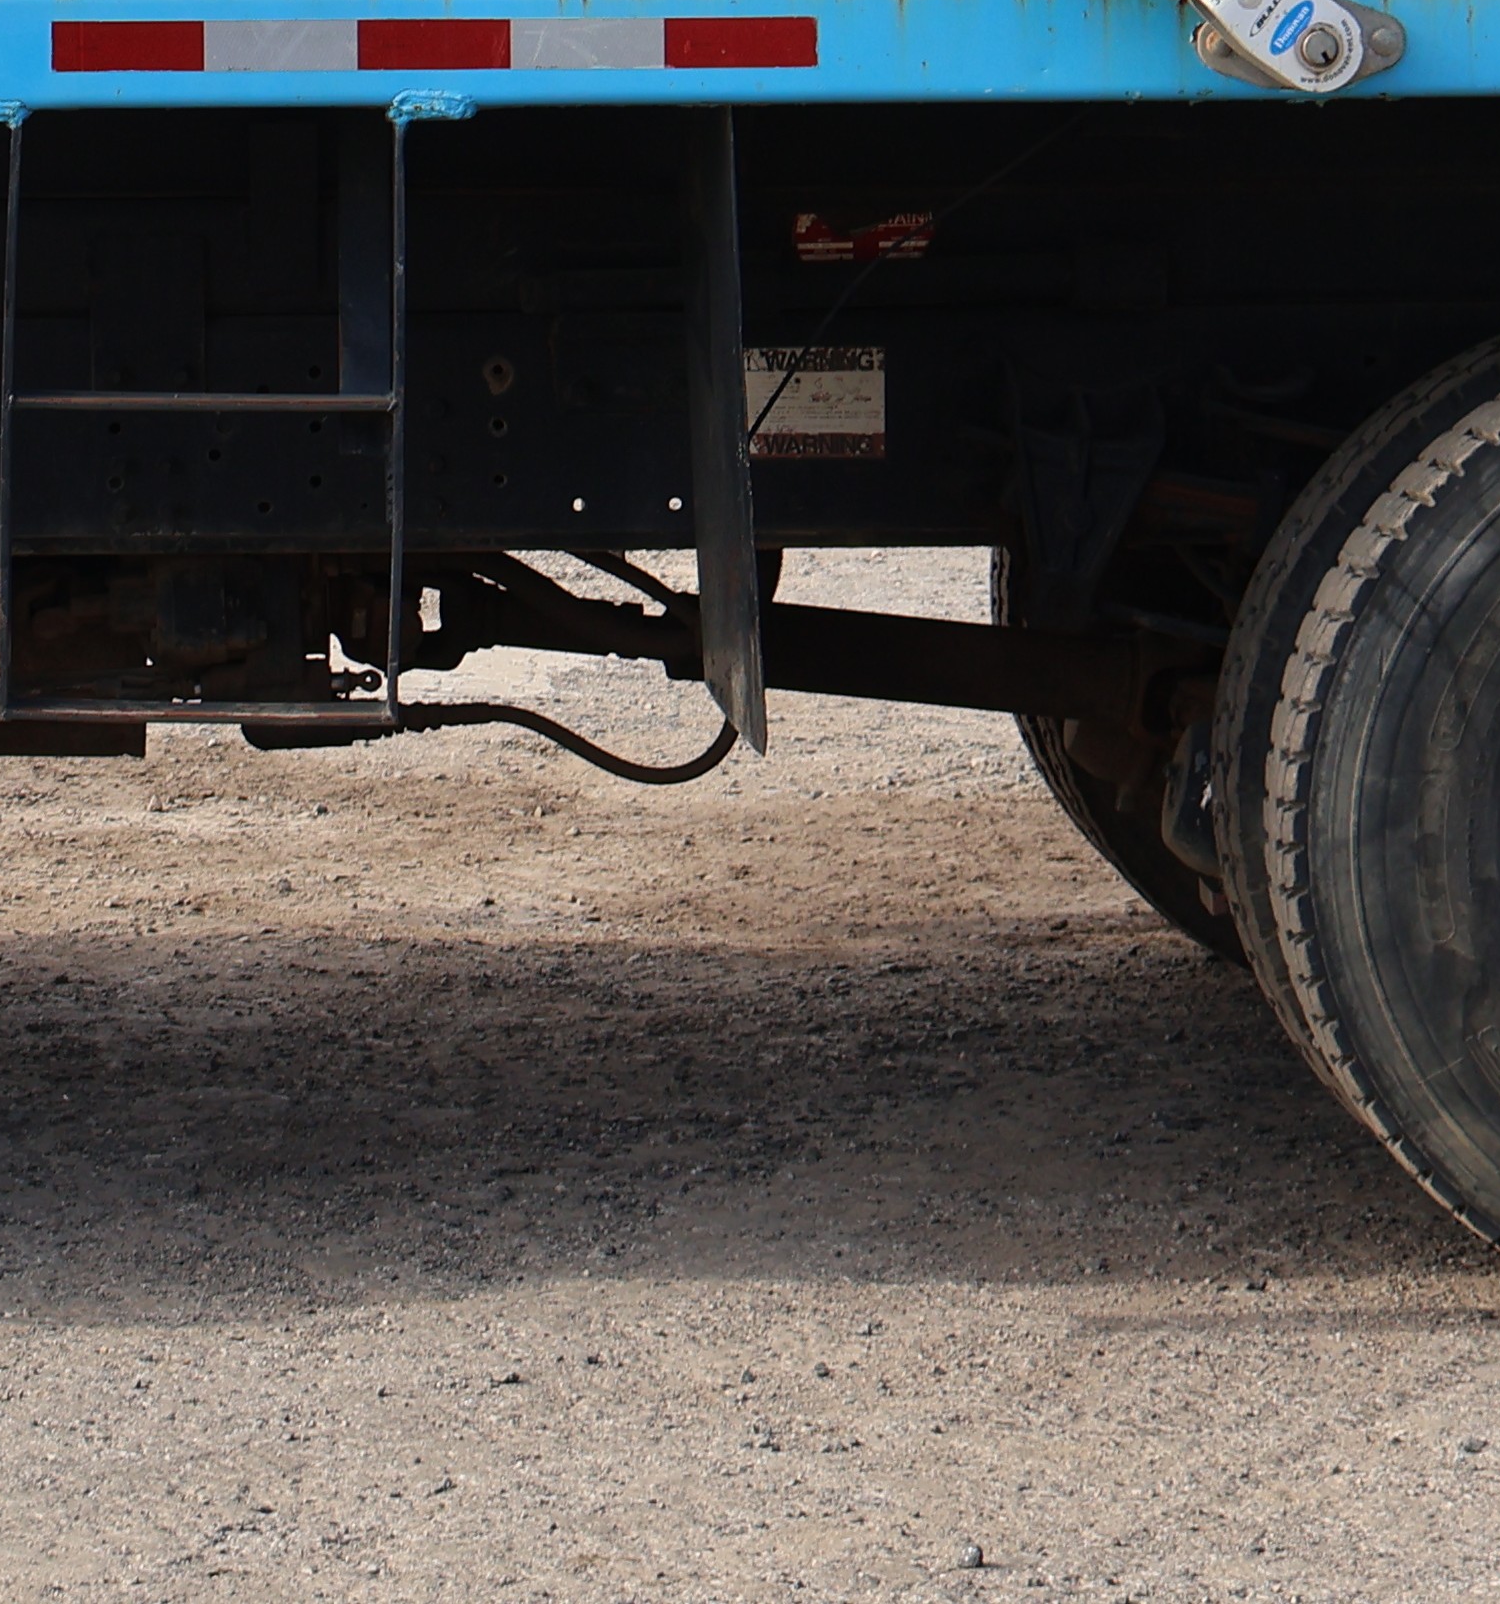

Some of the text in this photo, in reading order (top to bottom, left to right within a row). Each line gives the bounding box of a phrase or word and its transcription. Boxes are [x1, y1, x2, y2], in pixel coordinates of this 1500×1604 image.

[1274, 6, 1310, 49] Donovan
[760, 349, 875, 371] WARNING
[762, 434, 875, 455] WARNING
